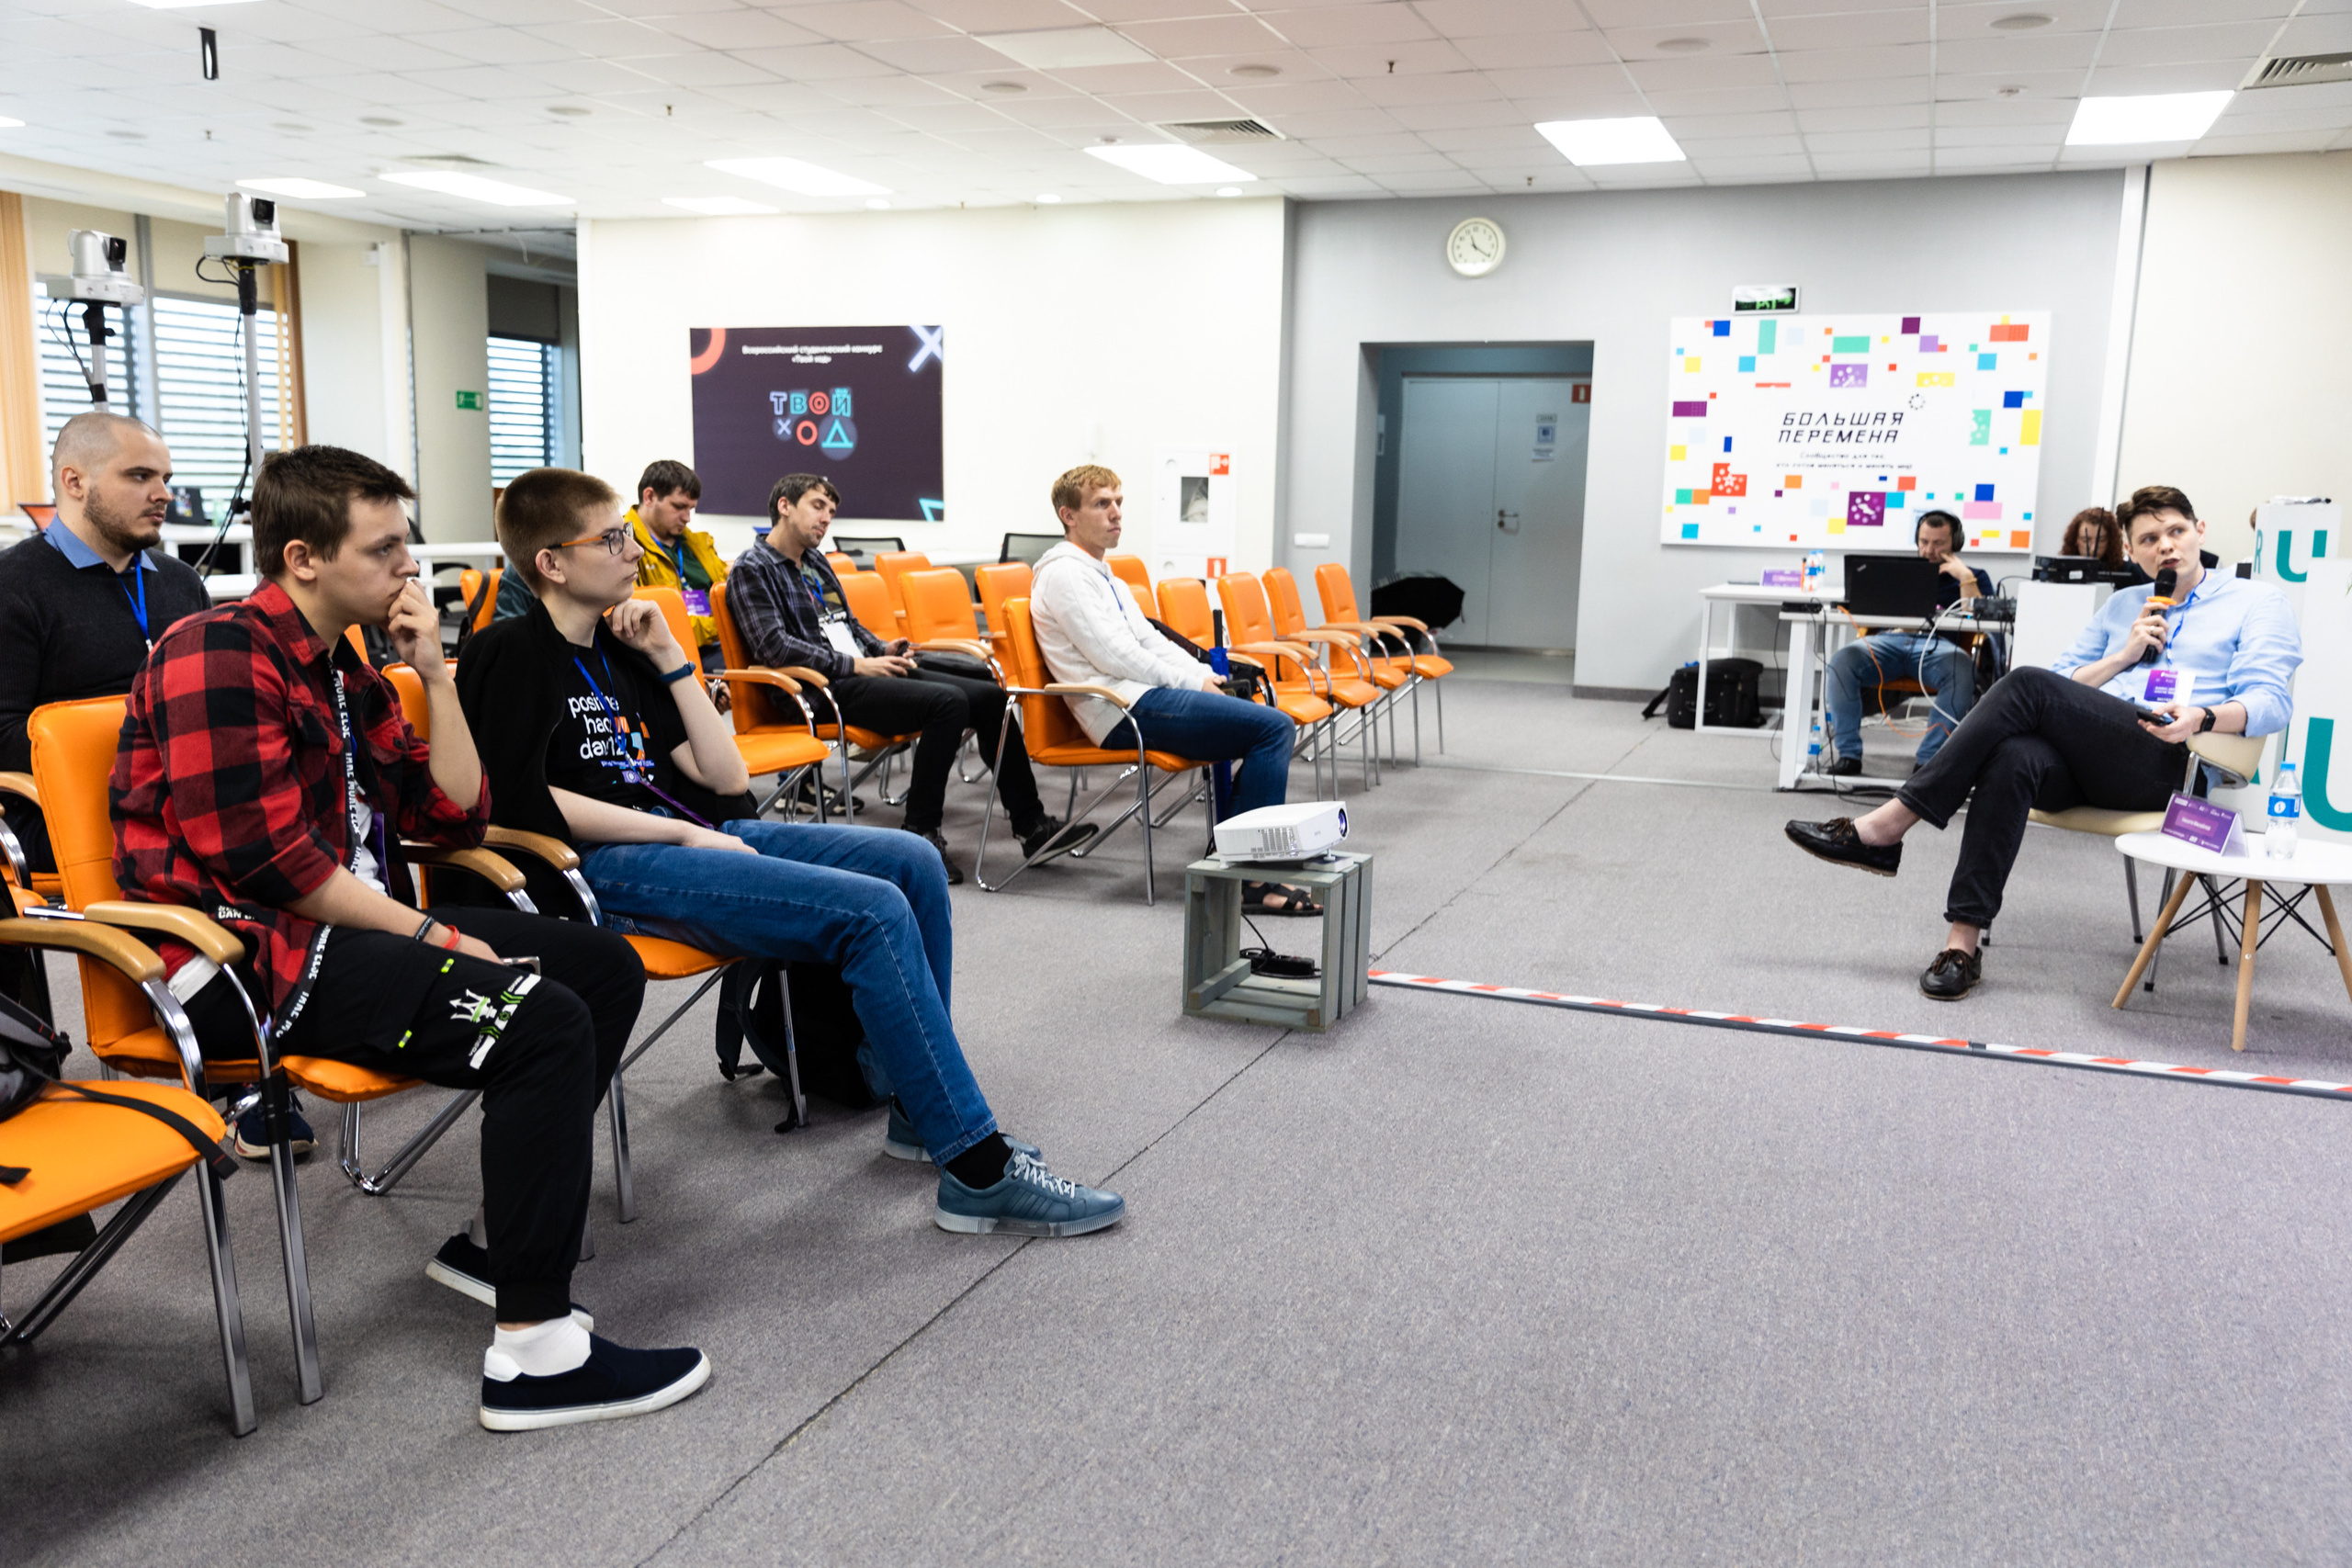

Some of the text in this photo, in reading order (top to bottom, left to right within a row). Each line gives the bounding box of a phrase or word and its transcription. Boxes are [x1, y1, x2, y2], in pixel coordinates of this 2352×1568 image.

[770, 388, 852, 417] ТВОЙ
[1782, 412, 1905, 426] БОЛЬШАЯ
[1778, 429, 1899, 444] ПЕРЕМЕНА
[2276, 530, 2328, 582] U
